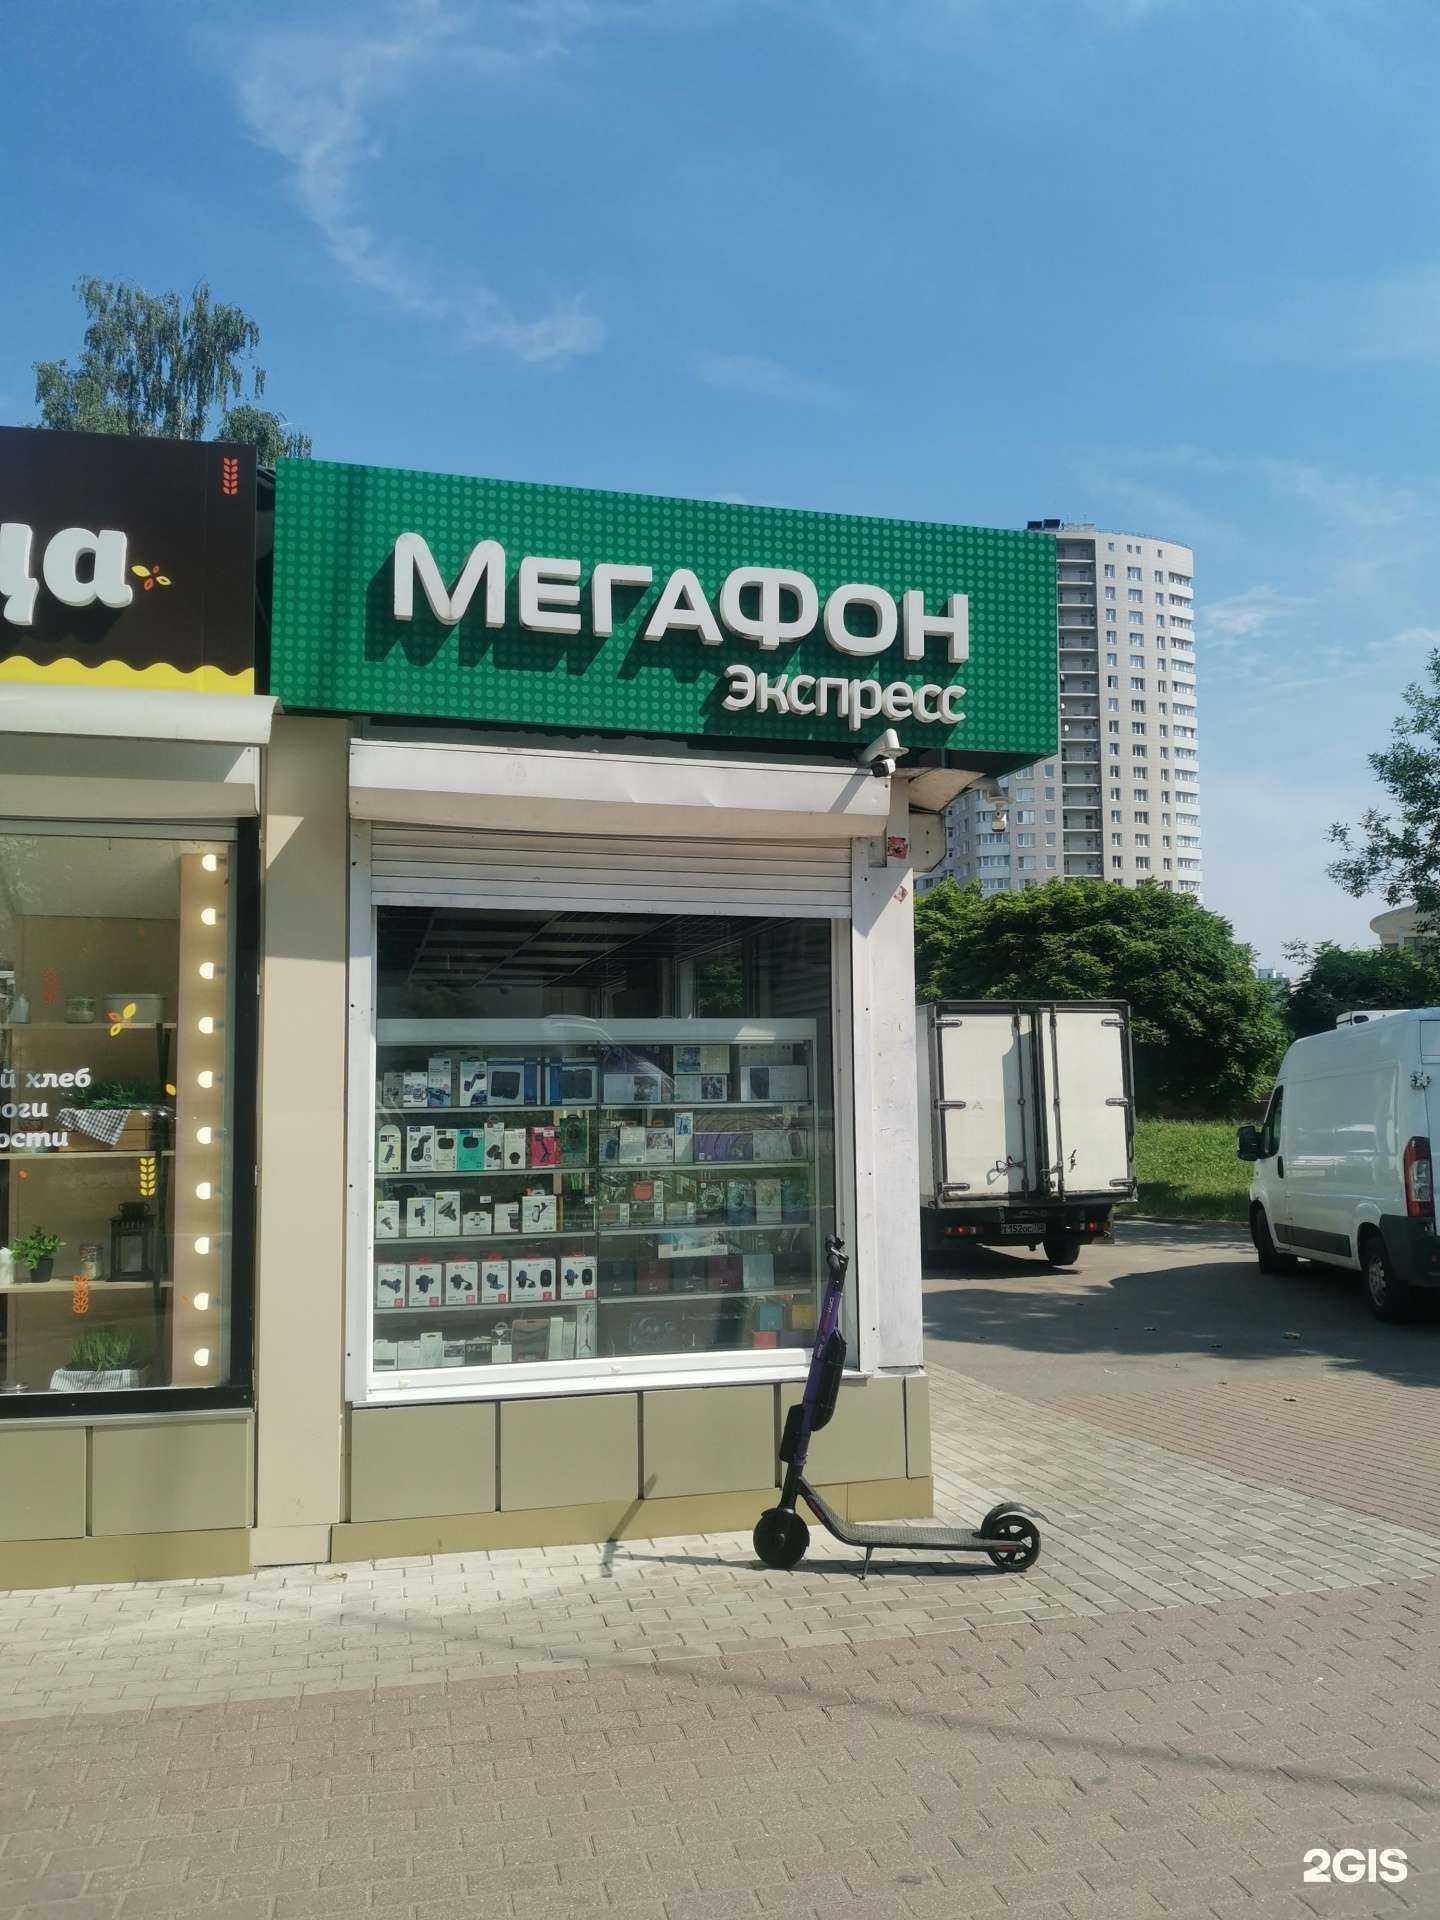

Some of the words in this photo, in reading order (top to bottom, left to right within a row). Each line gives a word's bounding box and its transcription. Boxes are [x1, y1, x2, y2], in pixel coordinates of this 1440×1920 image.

[394, 532, 969, 664] МЕГАФОН
[721, 664, 967, 731] Экспресс
[25, 1067, 92, 1089] хлеб
